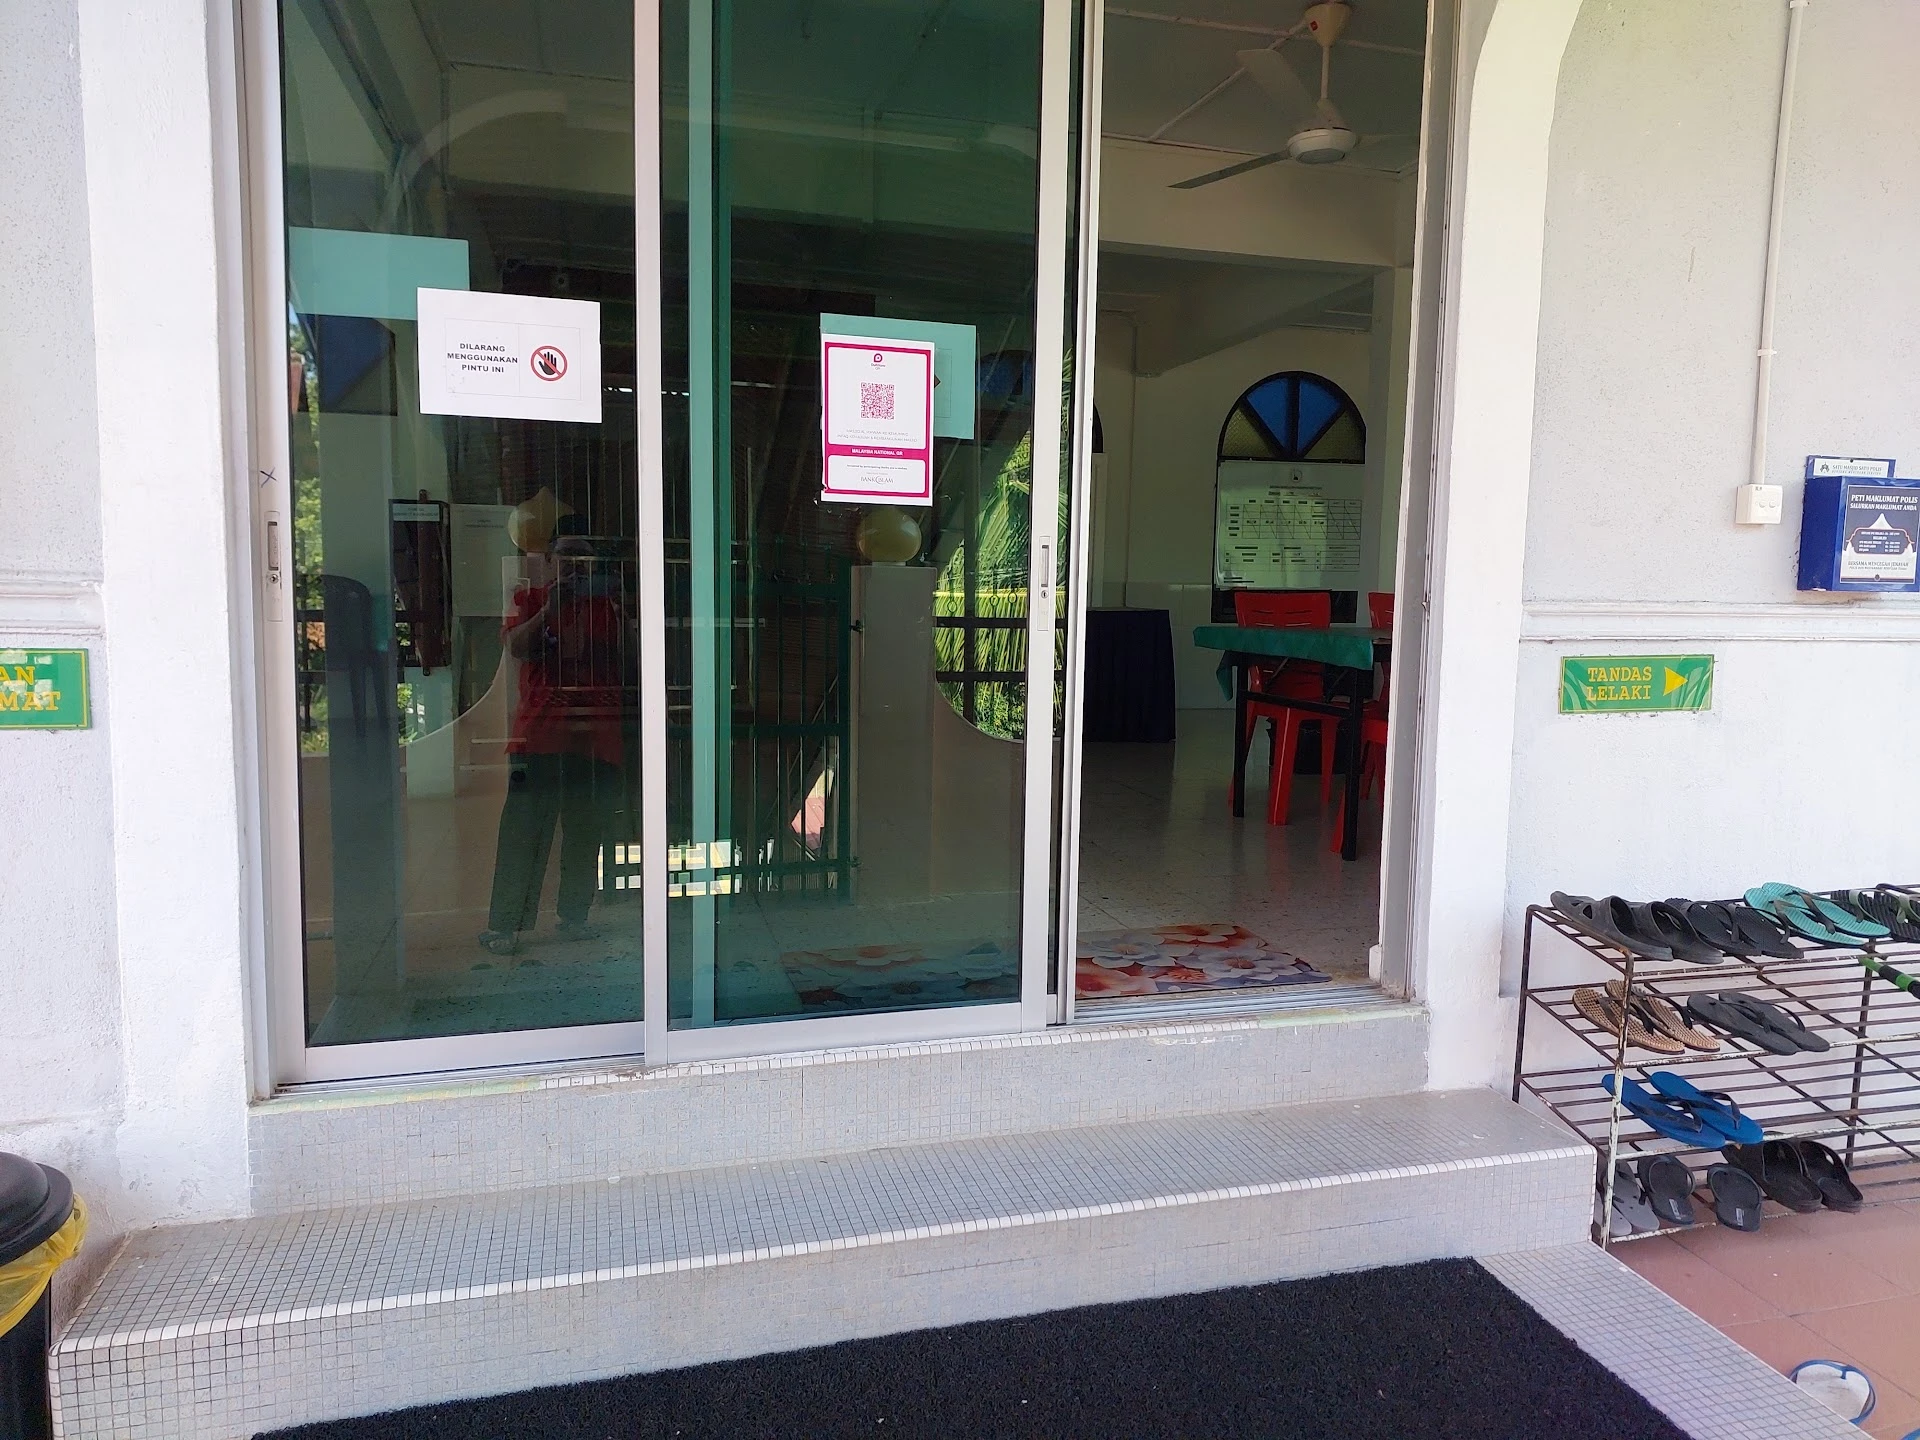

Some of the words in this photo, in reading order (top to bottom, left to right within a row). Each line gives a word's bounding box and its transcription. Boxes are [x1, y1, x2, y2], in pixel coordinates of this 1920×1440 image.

[460, 342, 506, 352] DILARANG
[447, 352, 518, 363] MENGGUNAKAN
[1851, 494, 1865, 502] PETI
[1865, 494, 1900, 503] MAKLUMAT
[1900, 496, 1919, 504] POLIS
[1587, 666, 1652, 683] TANDAS
[1586, 684, 1652, 701] LELAKI
